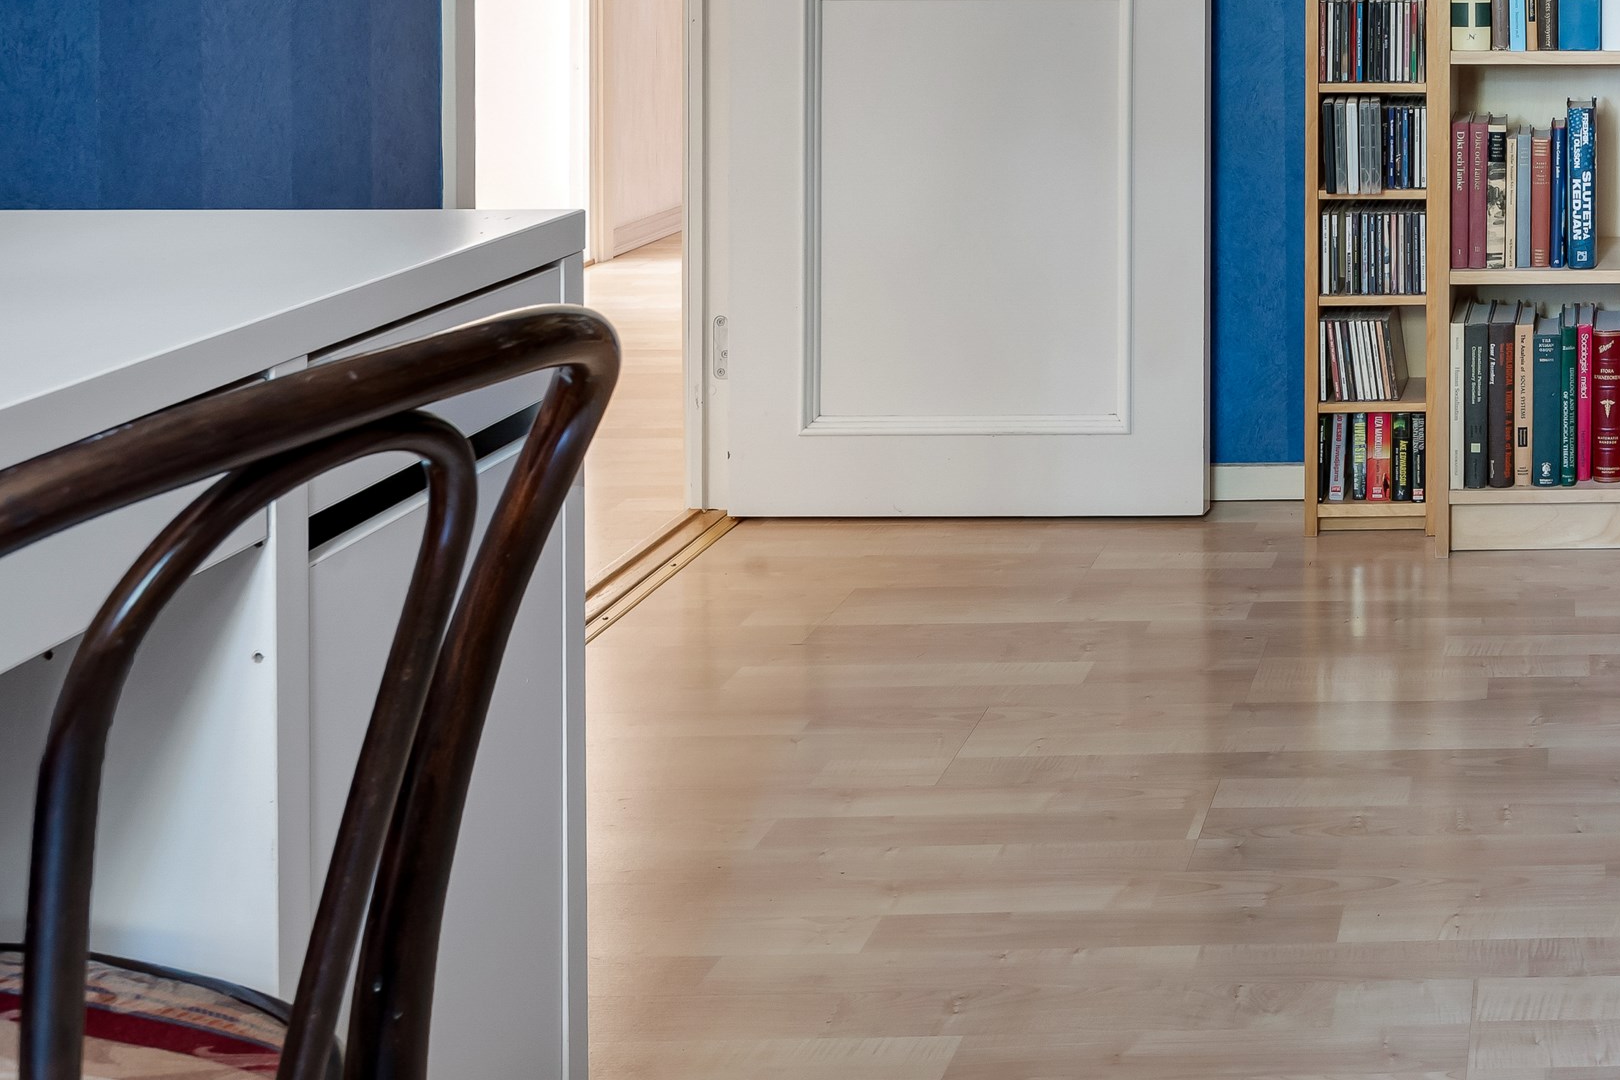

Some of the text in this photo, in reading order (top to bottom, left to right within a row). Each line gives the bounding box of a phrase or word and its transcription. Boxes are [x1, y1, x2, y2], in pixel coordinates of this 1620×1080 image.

[1573, 179, 1581, 240] KEDJAN
[1583, 171, 1591, 228] SLUTET
[1580, 334, 1588, 398] Sociologisk metod
